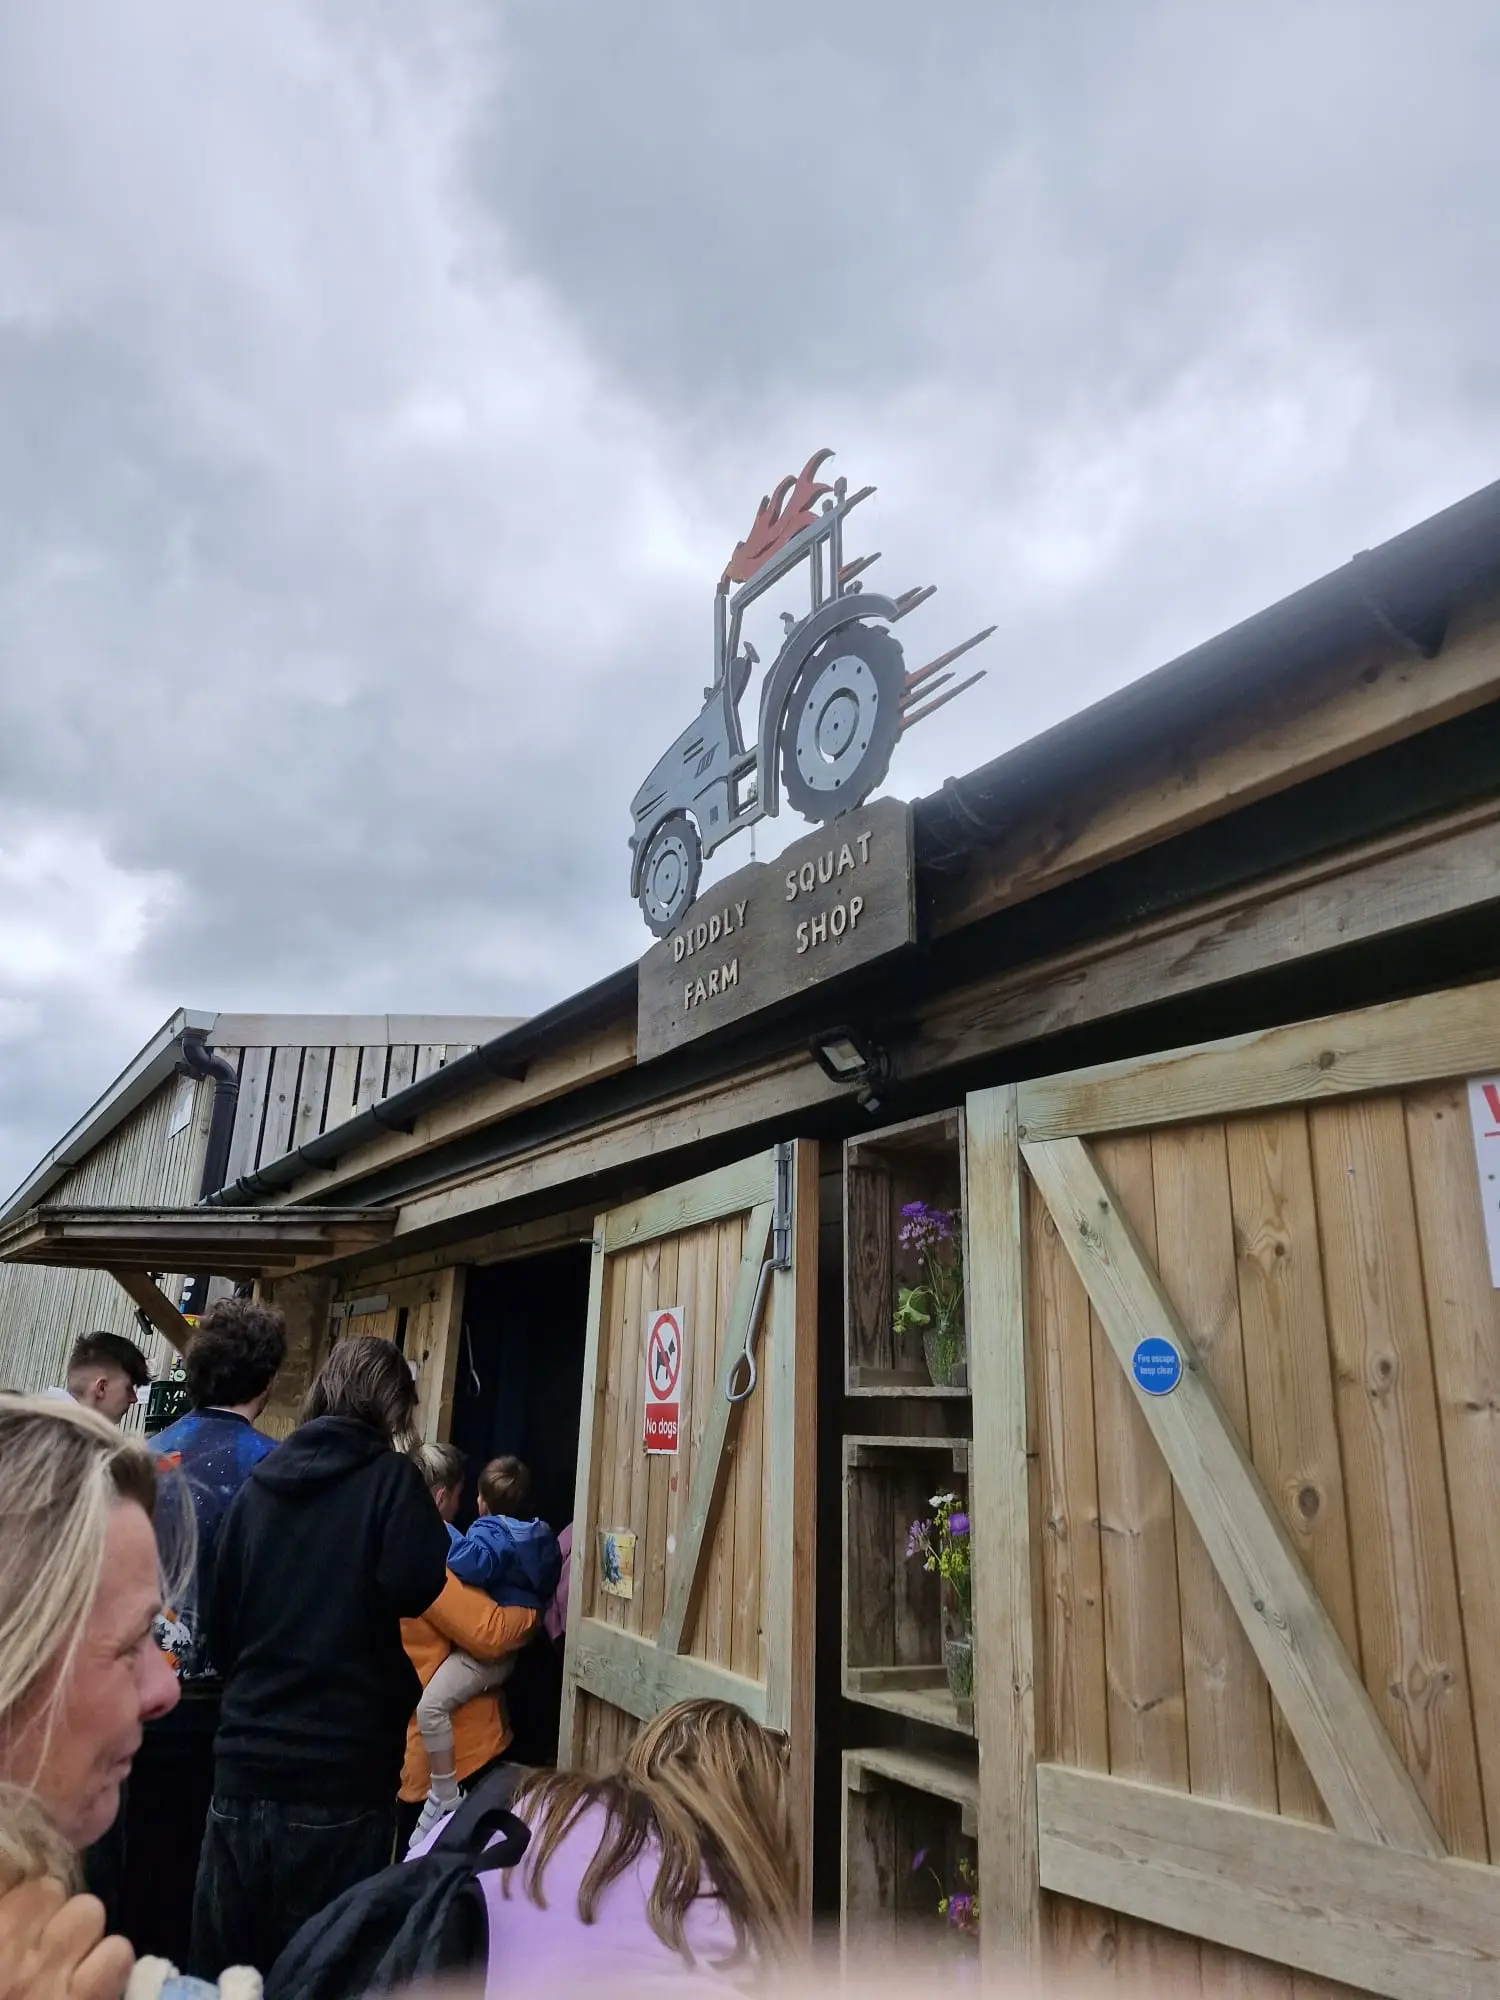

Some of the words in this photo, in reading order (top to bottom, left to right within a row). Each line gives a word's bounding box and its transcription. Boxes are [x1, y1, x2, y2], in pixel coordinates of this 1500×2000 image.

[673, 900, 749, 963] DIDDLY
[785, 831, 873, 901] SQUAT
[683, 959, 739, 1010] FARM
[796, 896, 864, 954] SHOP
[647, 1418, 657, 1434] No
[659, 1418, 677, 1439] dogs
